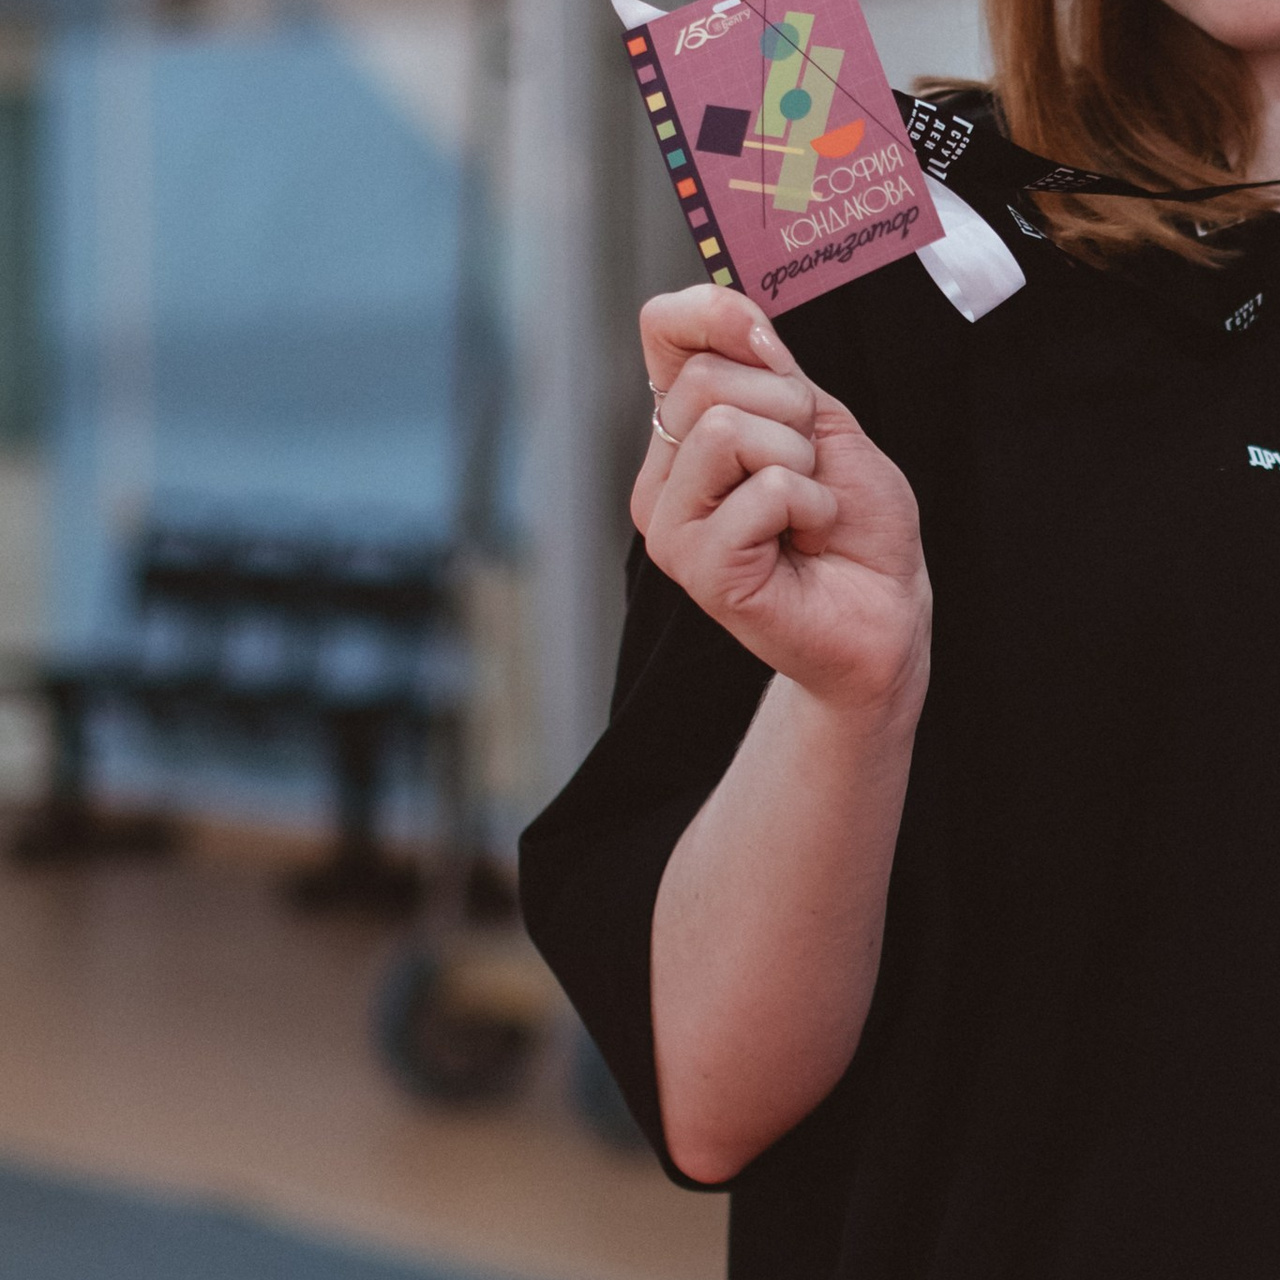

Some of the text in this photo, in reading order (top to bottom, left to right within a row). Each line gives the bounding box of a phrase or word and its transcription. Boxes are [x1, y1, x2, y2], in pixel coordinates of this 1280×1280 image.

[910, 113, 930, 140] ТОВ
[924, 118, 946, 150] ДЕН
[941, 130, 962, 157] СТУ
[810, 143, 905, 202] СОФИЯ
[780, 175, 915, 252] КОНДАКОВА
[761, 205, 920, 300] организатор
